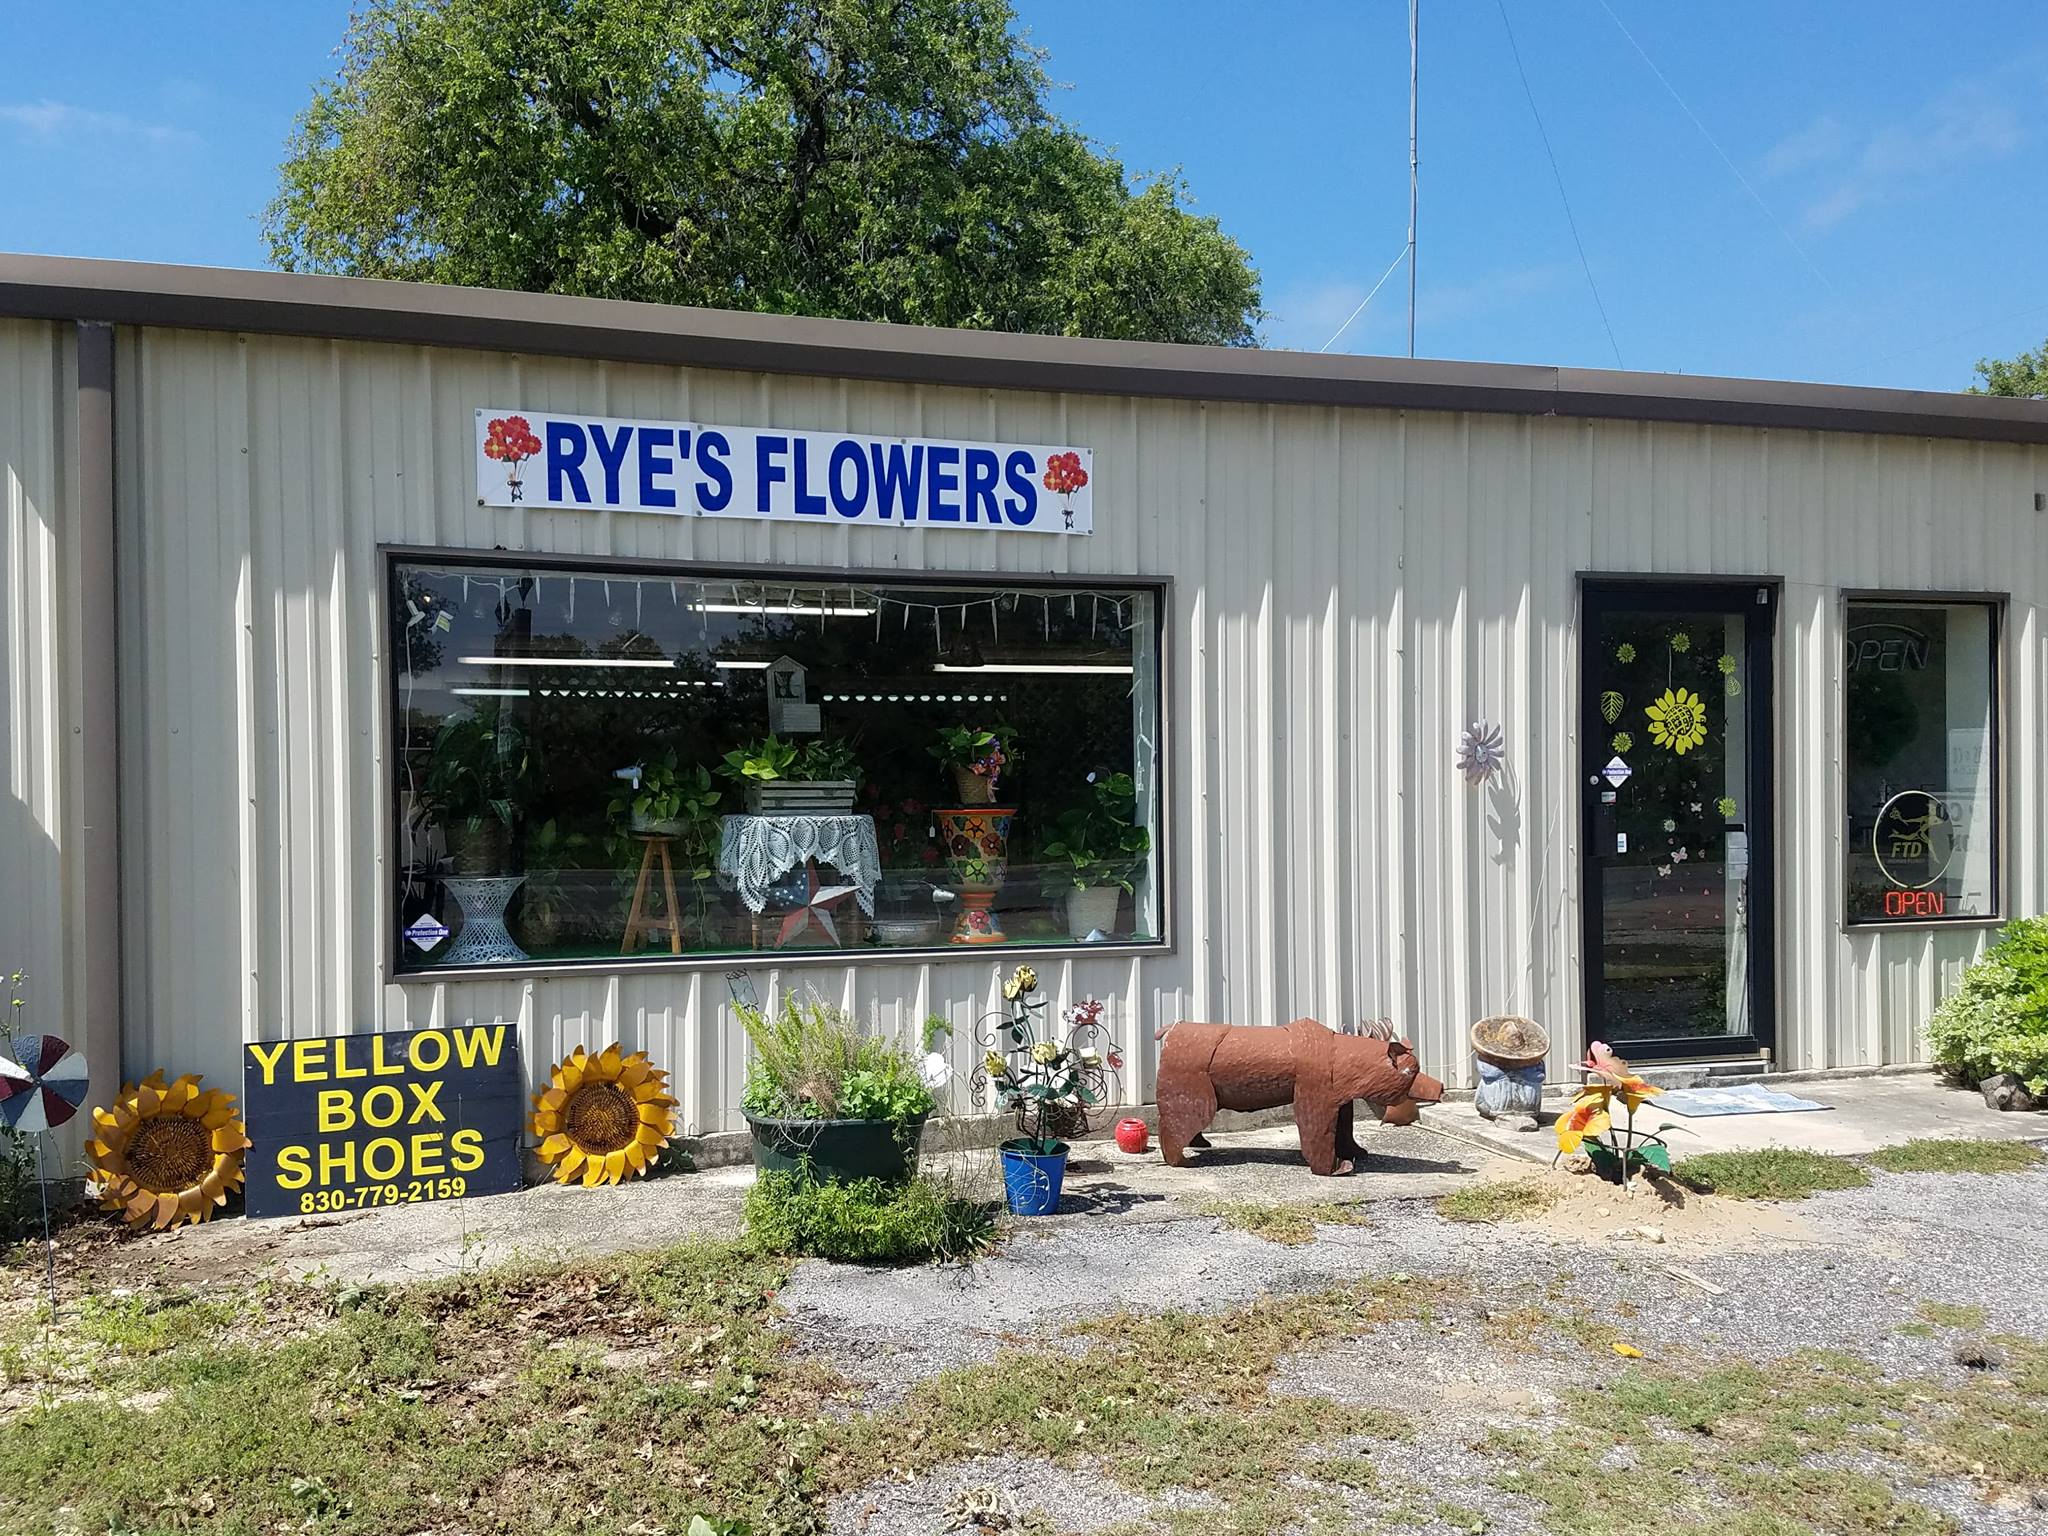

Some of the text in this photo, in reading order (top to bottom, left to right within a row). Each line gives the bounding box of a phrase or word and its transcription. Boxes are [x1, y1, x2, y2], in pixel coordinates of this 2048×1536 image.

[545, 421, 1038, 526] RYE'S FLOWERS
[1891, 841, 1922, 858] FTD
[1885, 891, 1944, 915] OPEN
[249, 1026, 506, 1085] YELLOW
[318, 1080, 446, 1133] BOX
[275, 1129, 485, 1190] SHOES
[300, 1177, 466, 1214] 830-779-2159
